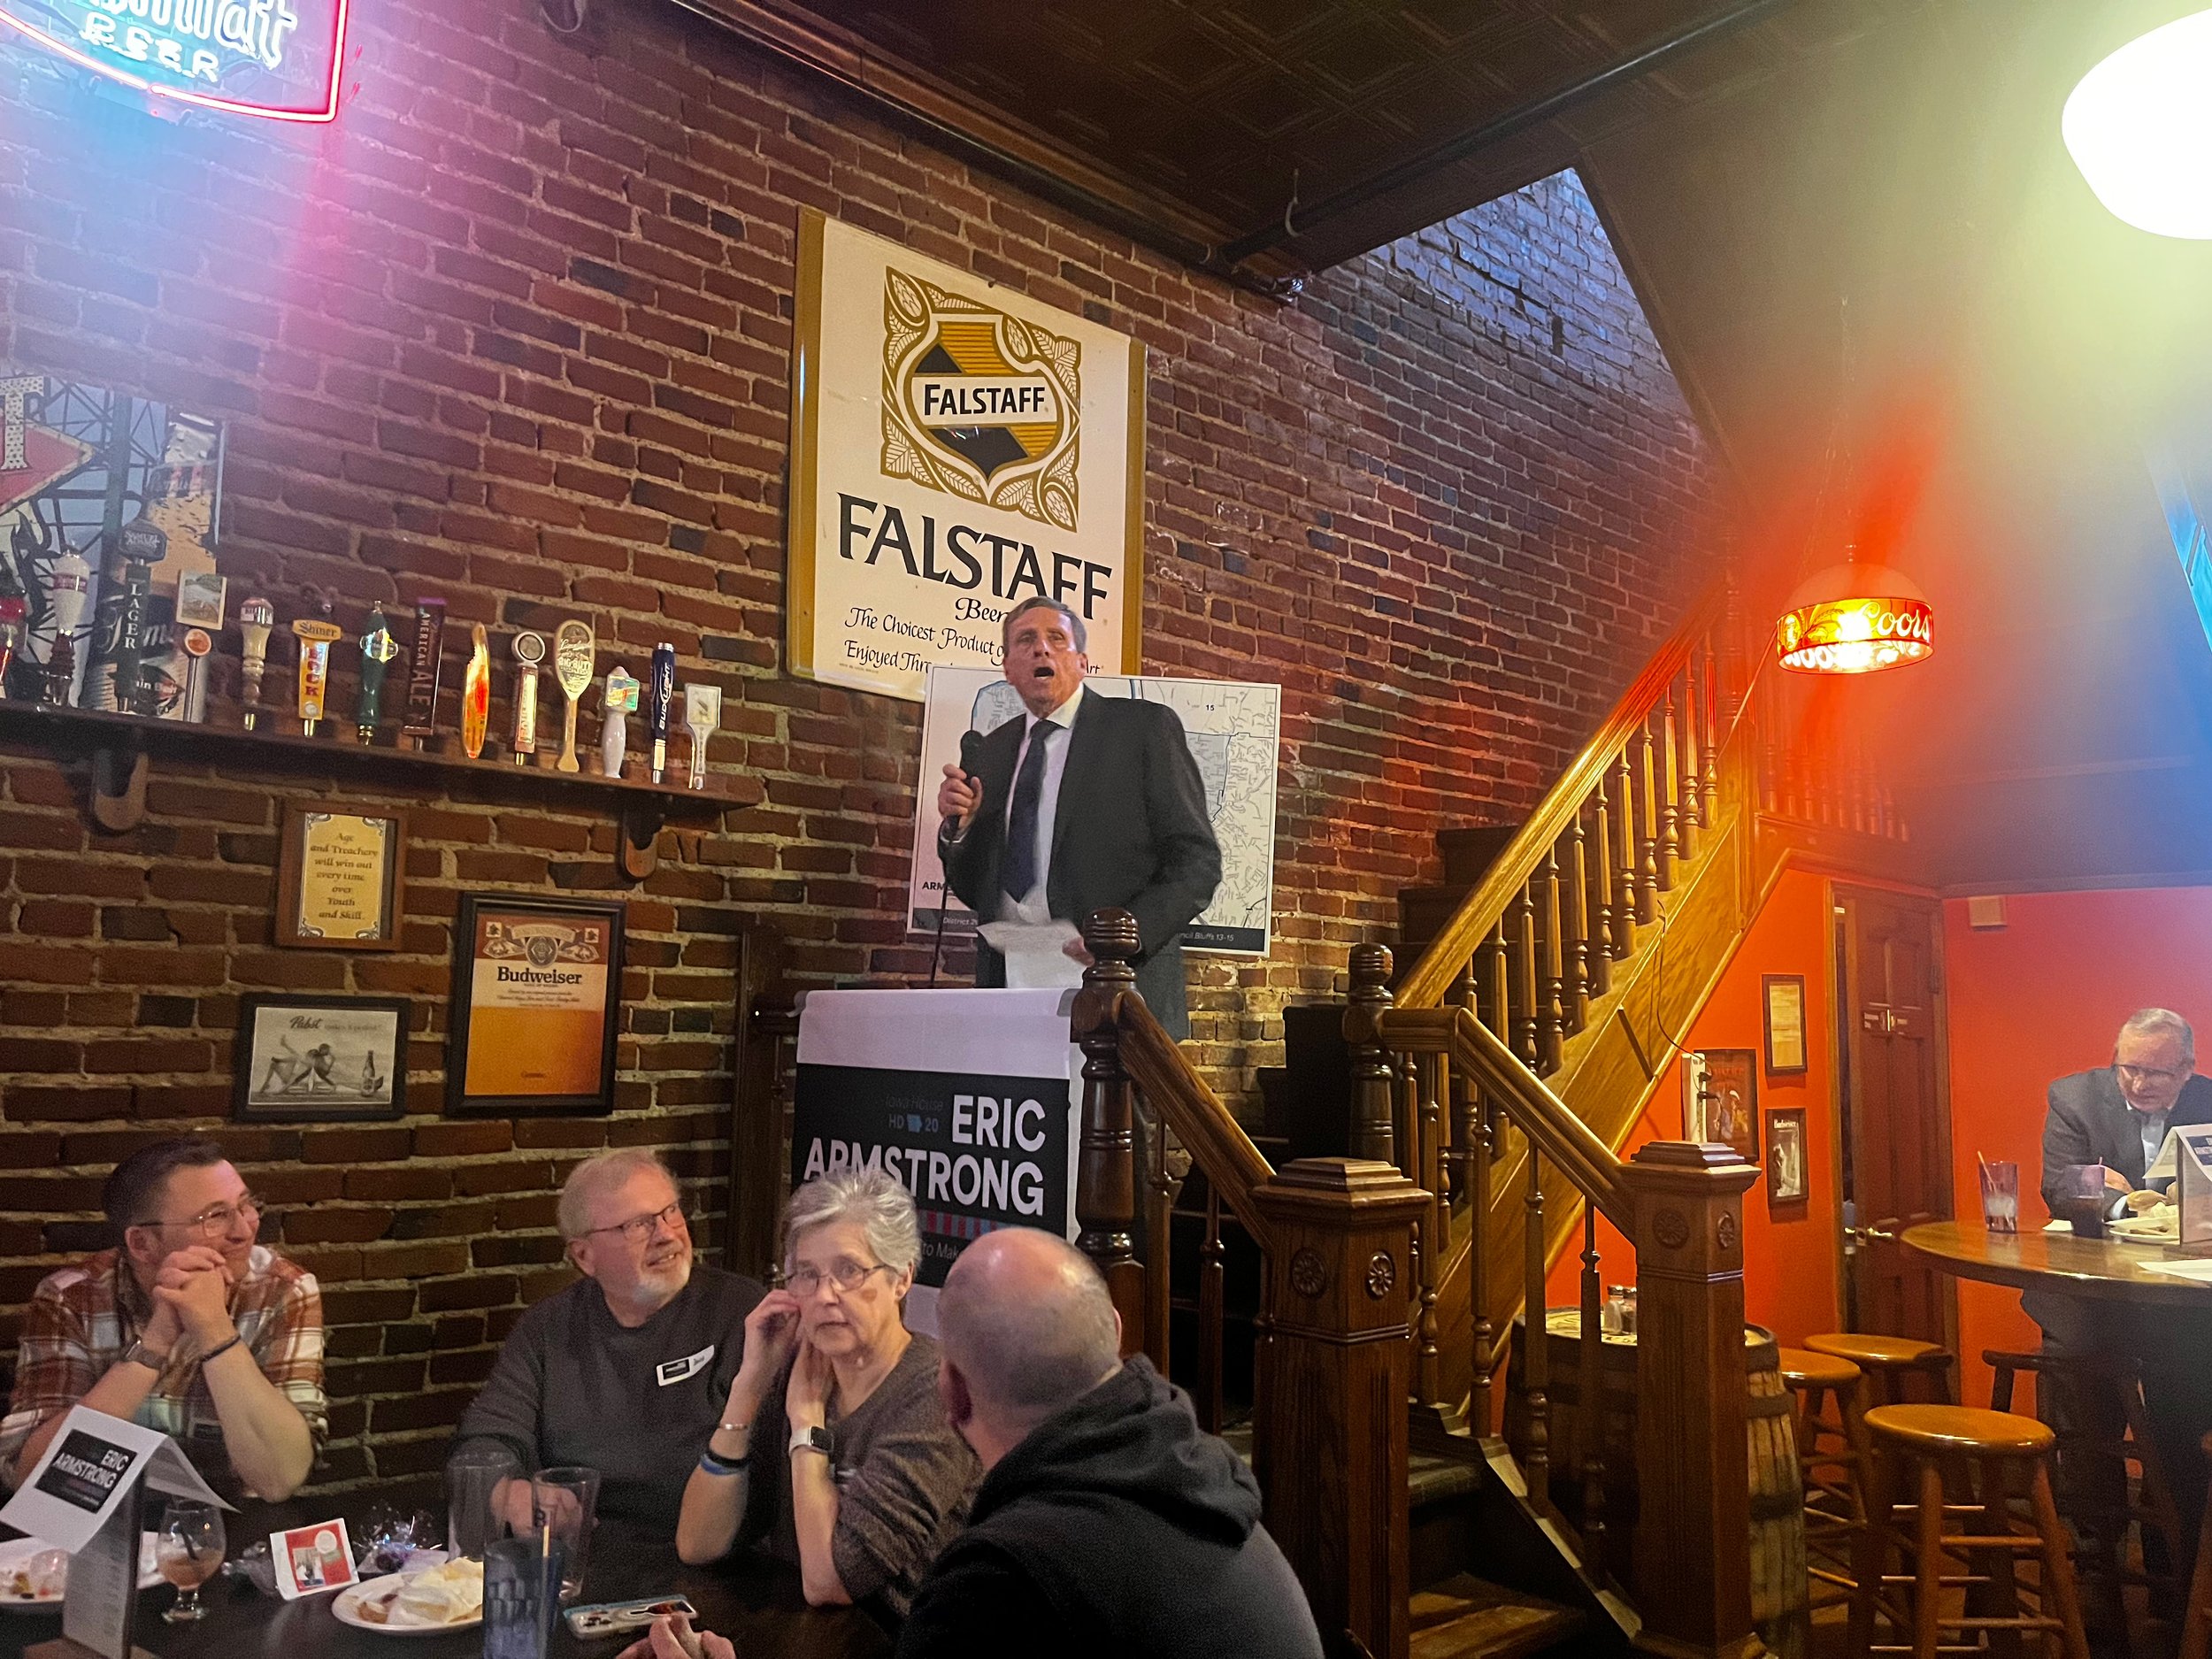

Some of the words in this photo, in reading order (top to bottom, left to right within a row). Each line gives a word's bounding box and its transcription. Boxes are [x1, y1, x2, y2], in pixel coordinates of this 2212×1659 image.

[923, 383, 1046, 416] FALSTAFF
[837, 492, 1112, 620] FALSTAFF
[124, 583, 142, 650] LAGER
[956, 597, 1010, 623] Beer
[1855, 601, 1931, 642] Coors
[298, 621, 337, 637] Shiner
[416, 611, 431, 666] AMERICAN
[844, 607, 879, 630] The
[882, 614, 937, 641] Choicest
[937, 627, 995, 657] Product
[844, 640, 899, 669] Enjoyed
[409, 669, 434, 706] ALE
[658, 703, 668, 731] BUD
[663, 662, 672, 699] LIGHT
[311, 844, 329, 853] and
[332, 845, 379, 857] Treachery
[314, 857, 334, 866] will
[336, 859, 355, 868] win
[356, 861, 373, 870] out
[316, 872, 342, 881] every
[343, 872, 365, 881] time
[922, 881, 951, 891] ARM
[326, 897, 356, 906] Youth
[319, 910, 337, 919] and
[942, 917, 970, 926] District
[1194, 932, 1215, 941] Bluffs
[496, 966, 582, 985] Budweiser
[289, 1015, 324, 1030] Pabst
[888, 1114, 905, 1130] HD
[925, 1117, 939, 1133] 20
[952, 1094, 1047, 1152] ERIC
[803, 1137, 1045, 1217] ARMSTRONG
[936, 1241, 960, 1260] Mak
[52, 1452, 118, 1488] ARMSTRONG
[100, 1448, 129, 1471] ERIC
